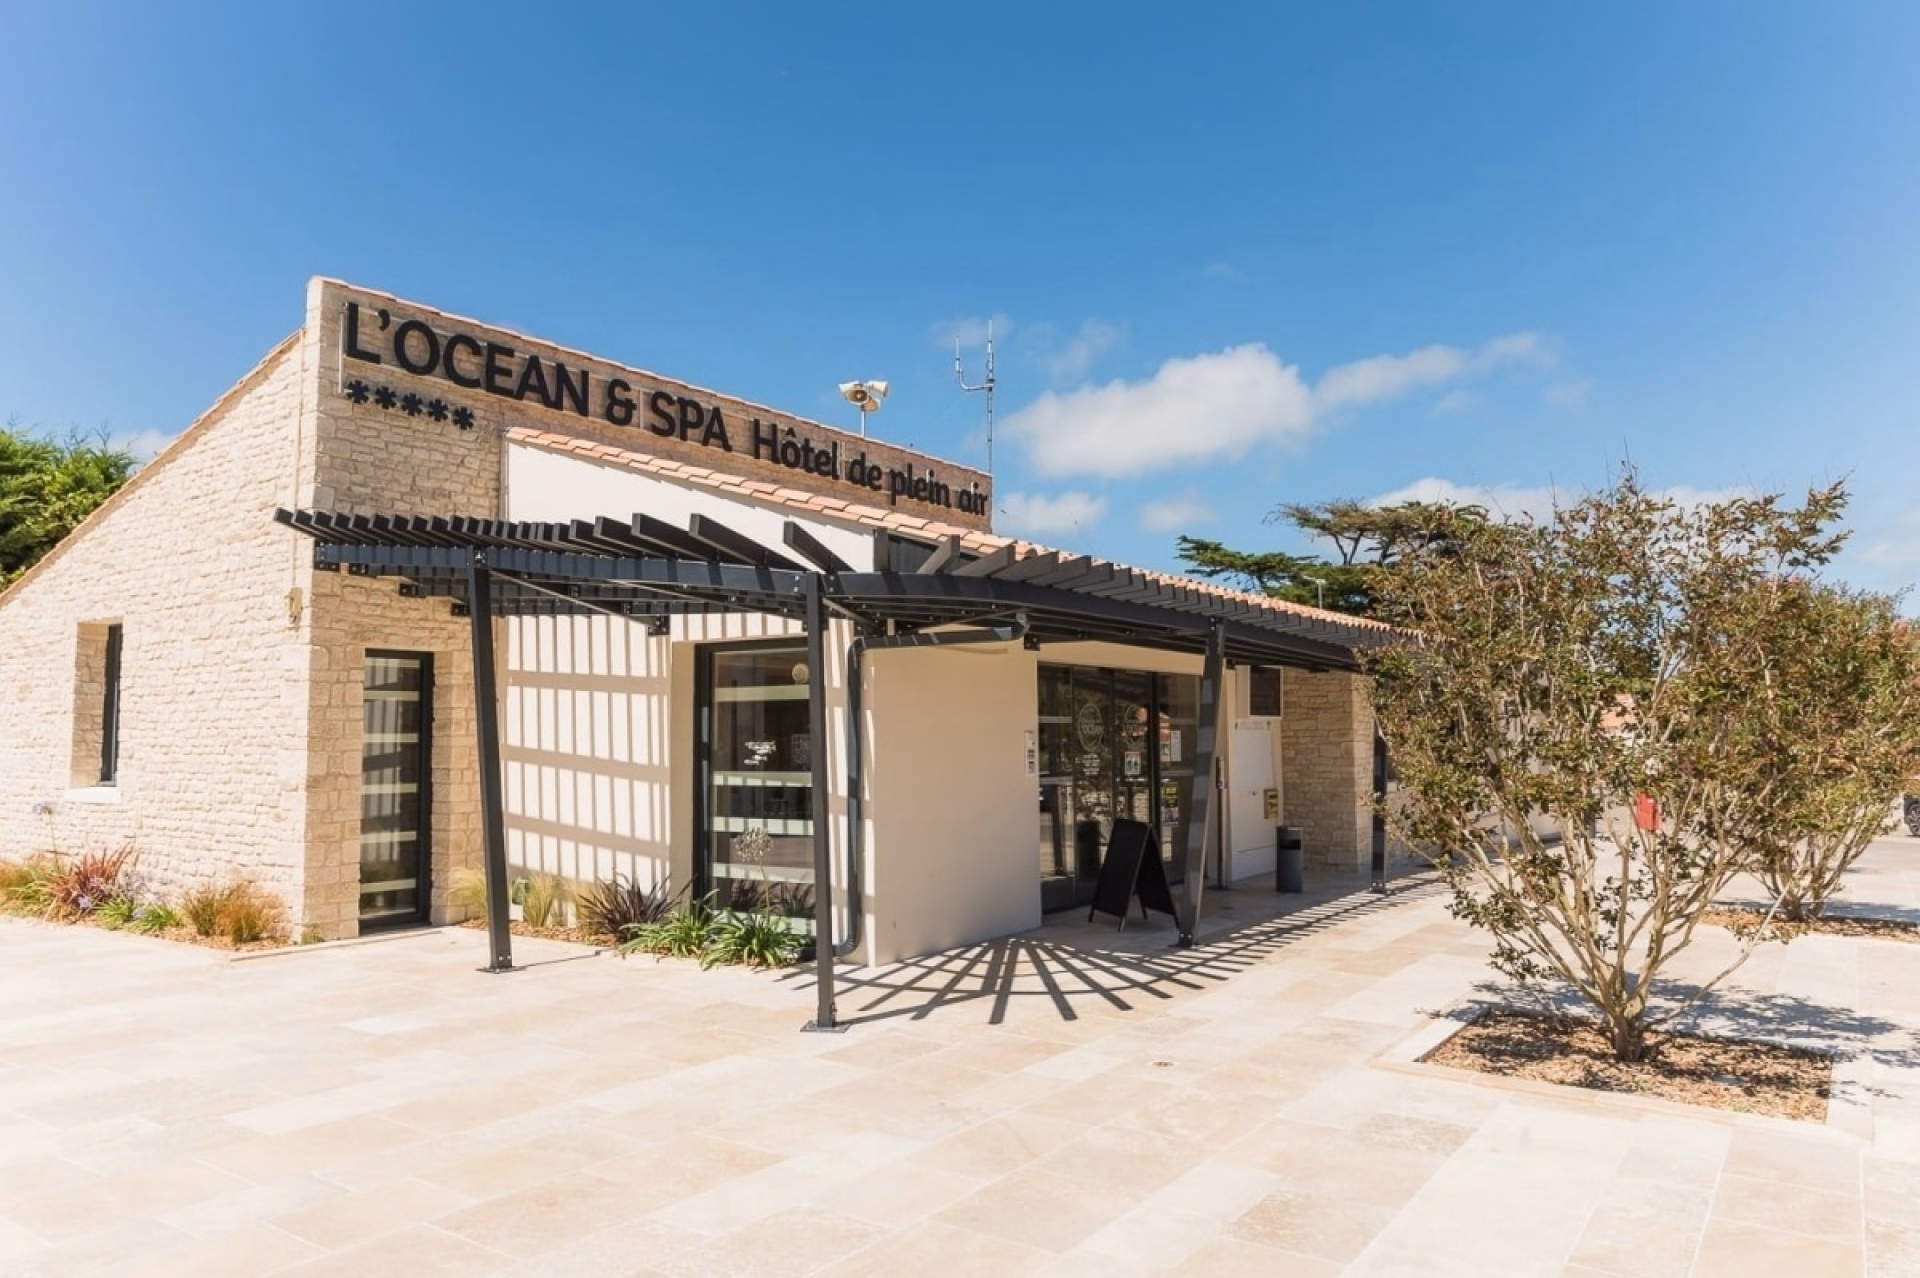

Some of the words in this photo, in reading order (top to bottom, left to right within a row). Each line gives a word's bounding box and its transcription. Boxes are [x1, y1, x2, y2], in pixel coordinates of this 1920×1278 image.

[345, 302, 590, 417] L'OCEAN
[606, 378, 637, 426] &
[650, 391, 732, 451] SPA
[753, 418, 840, 480] Hôtel
[850, 452, 883, 491] de
[890, 463, 951, 506] plein
[960, 482, 988, 516] air
